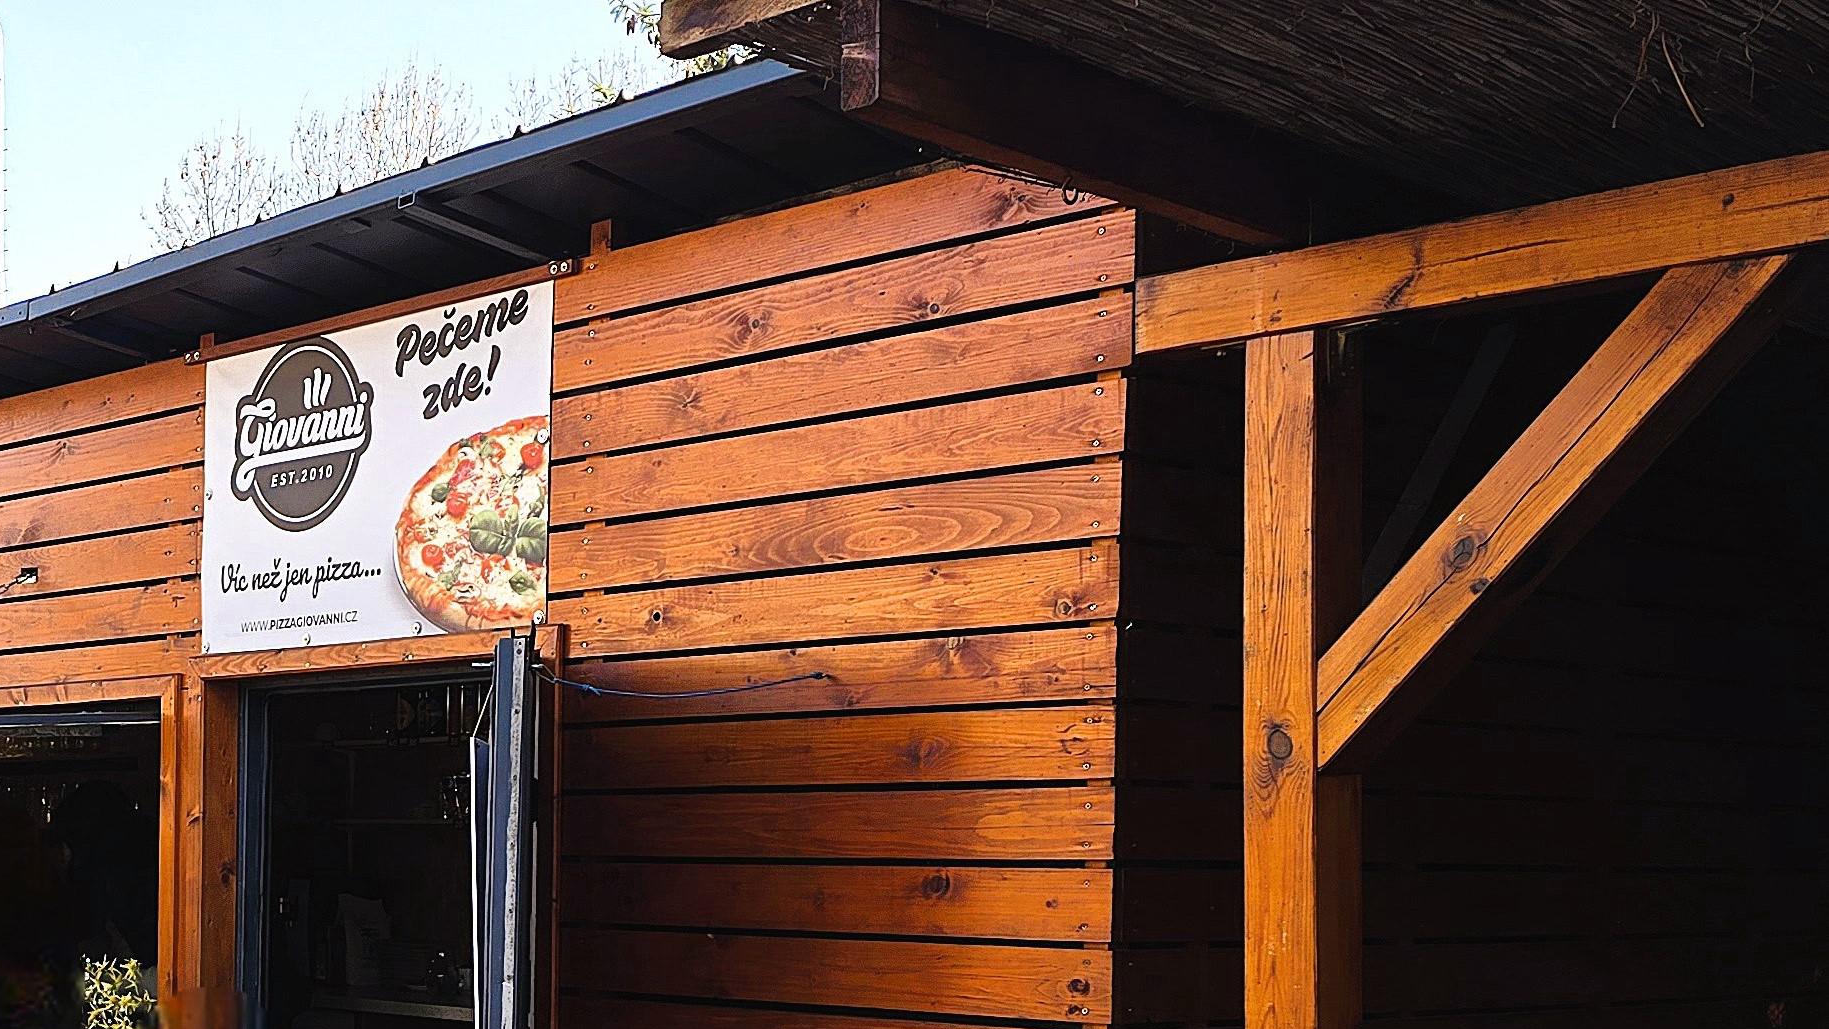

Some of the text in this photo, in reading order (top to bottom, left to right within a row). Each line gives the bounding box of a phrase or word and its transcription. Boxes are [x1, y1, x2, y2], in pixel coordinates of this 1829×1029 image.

[395, 289, 529, 377] Pečeme
[422, 344, 501, 420] zde!
[236, 391, 368, 491] Giovanni
[270, 464, 333, 488] EST.2010
[221, 556, 382, 602] Víc než jen pizza...
[240, 610, 358, 633] WWW.PIZZAGIOVANNI.CZ
